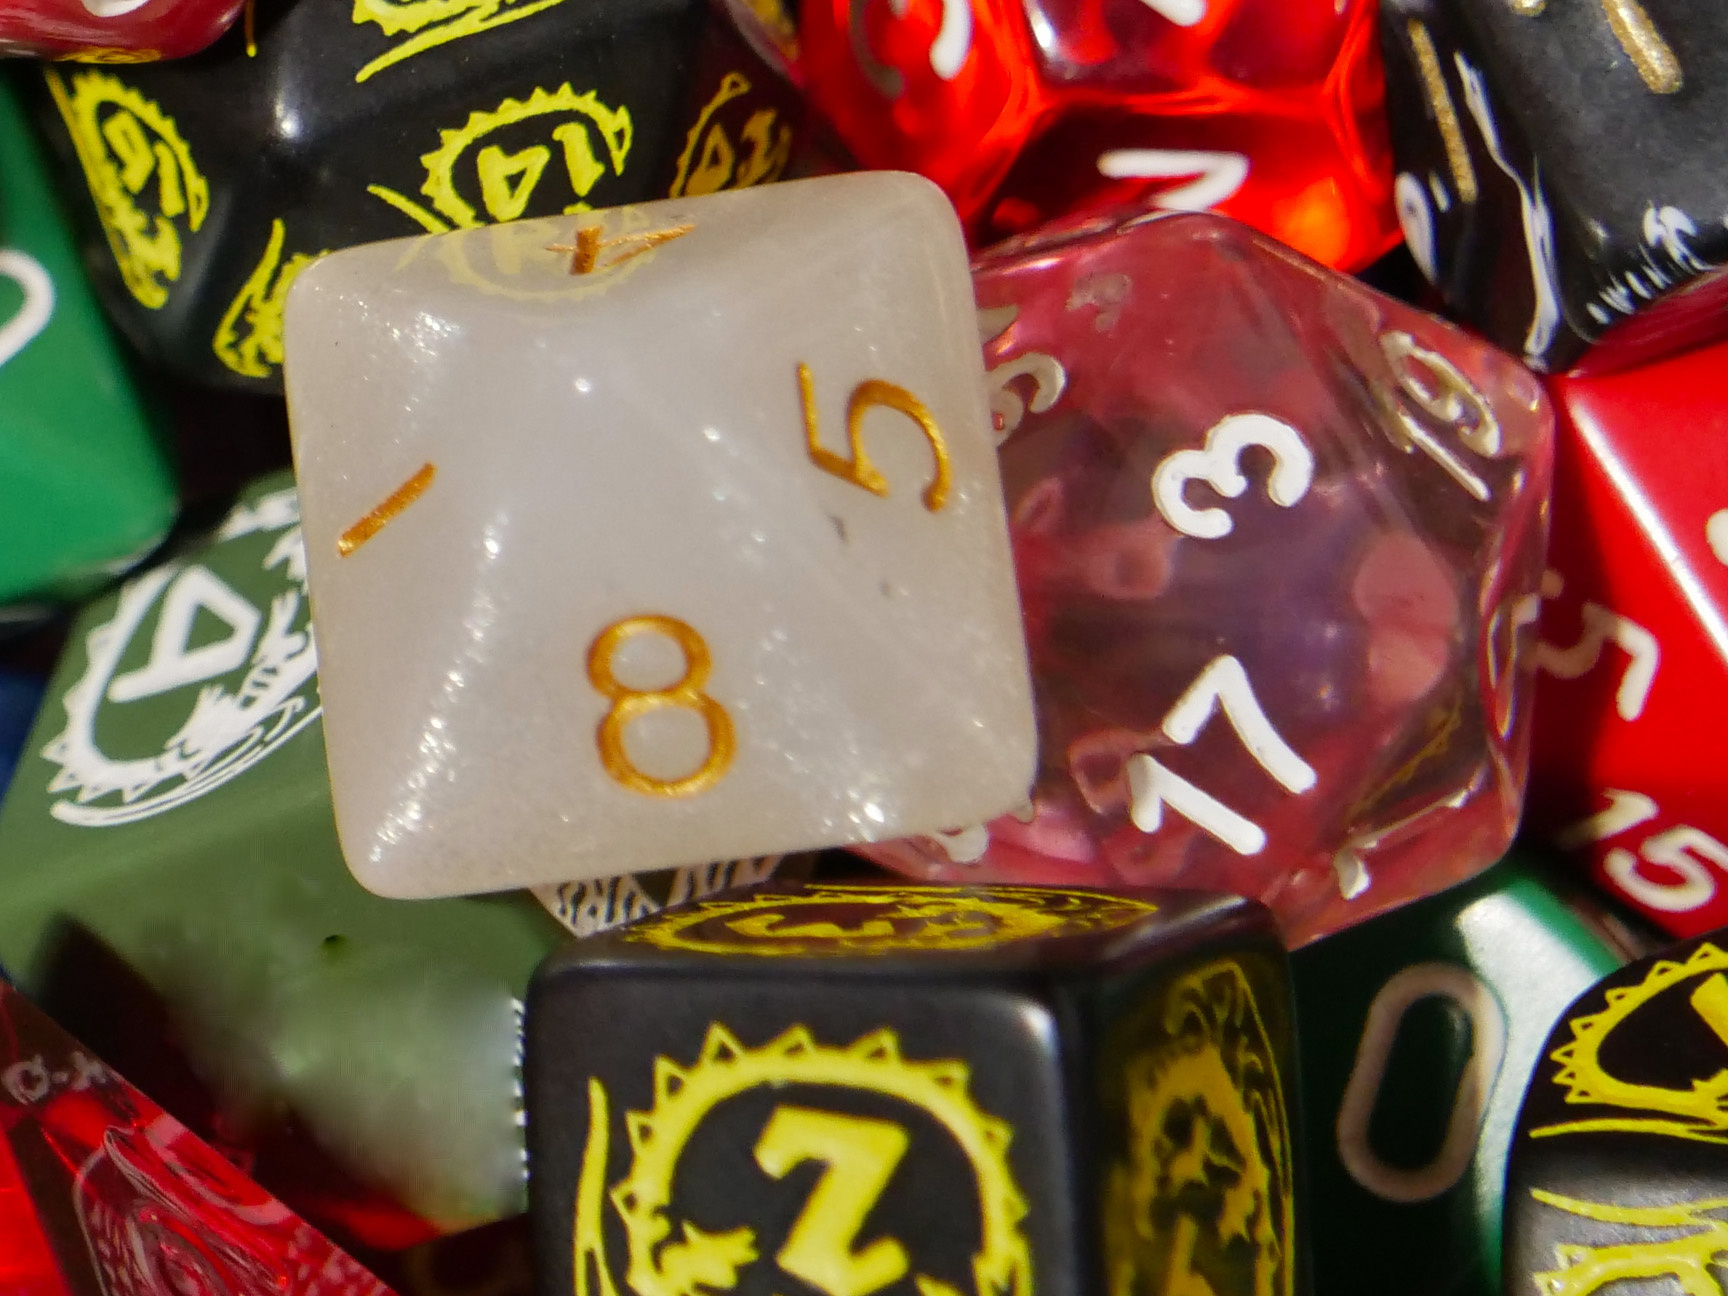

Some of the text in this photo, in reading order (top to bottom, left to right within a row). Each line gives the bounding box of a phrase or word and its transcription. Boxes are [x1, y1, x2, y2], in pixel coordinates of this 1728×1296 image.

[544, 222, 698, 278] 4
[796, 359, 954, 513] 5
[1150, 412, 1317, 541] 3
[332, 460, 438, 562] 1
[584, 611, 739, 800] 8
[1127, 654, 1318, 857] 17
[1574, 788, 1728, 912] 15
[1335, 960, 1512, 1205] 0
